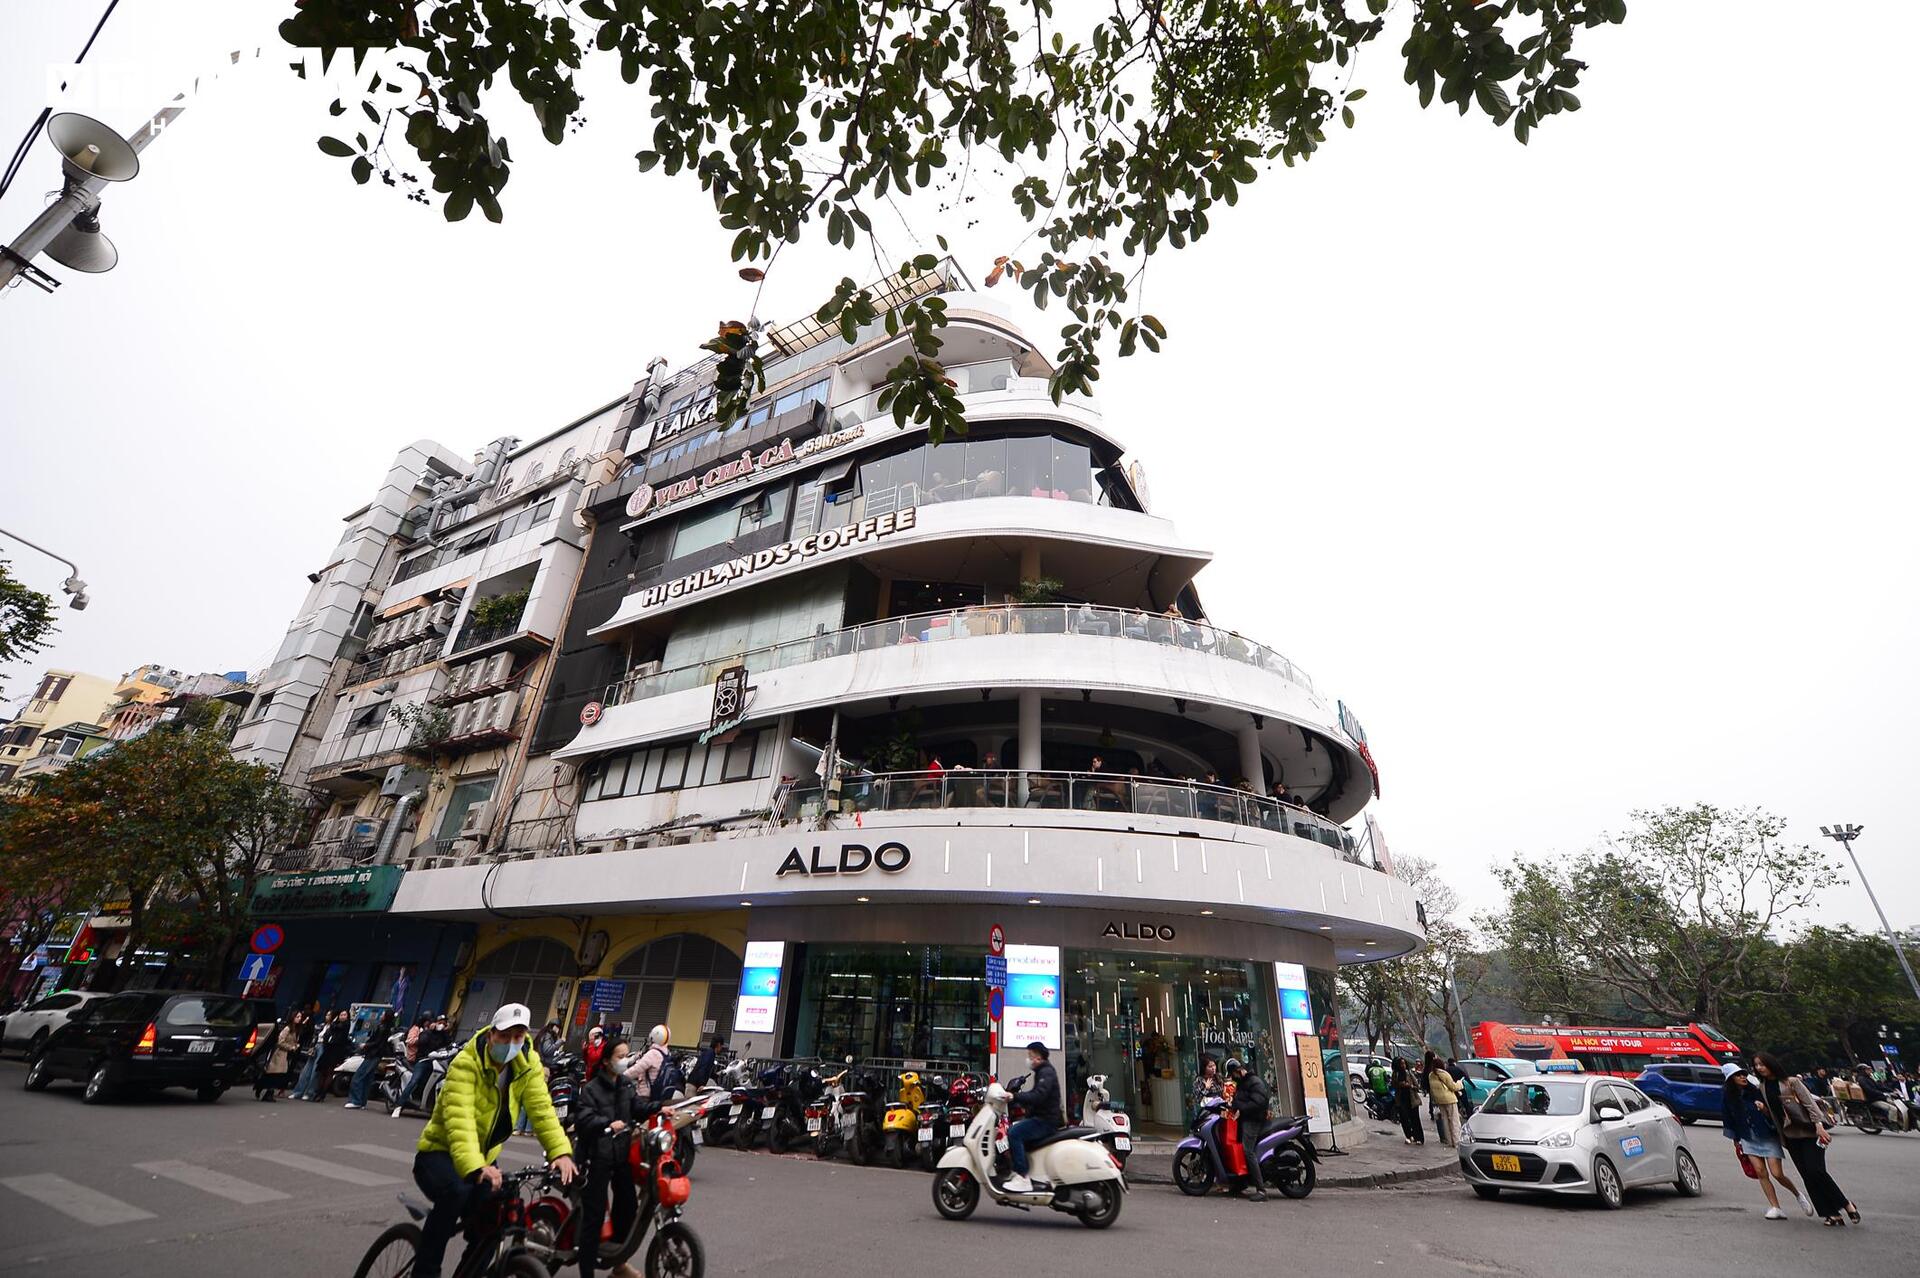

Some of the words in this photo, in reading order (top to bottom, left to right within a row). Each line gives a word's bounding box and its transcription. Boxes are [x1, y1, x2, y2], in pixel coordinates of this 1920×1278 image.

[655, 397, 718, 441] LAIKA
[654, 476, 699, 508] VUA
[641, 541, 793, 607] HIGHLANDS
[797, 506, 916, 557] COFFEE
[776, 841, 911, 877] ALDO
[1101, 921, 1176, 942] ALDO
[1571, 1038, 1583, 1046] HA
[1584, 1038, 1599, 1046] NOI
[1600, 1039, 1619, 1047] CITY
[1620, 1039, 1643, 1048] TOUR
[1305, 1061, 1318, 1079] 30
